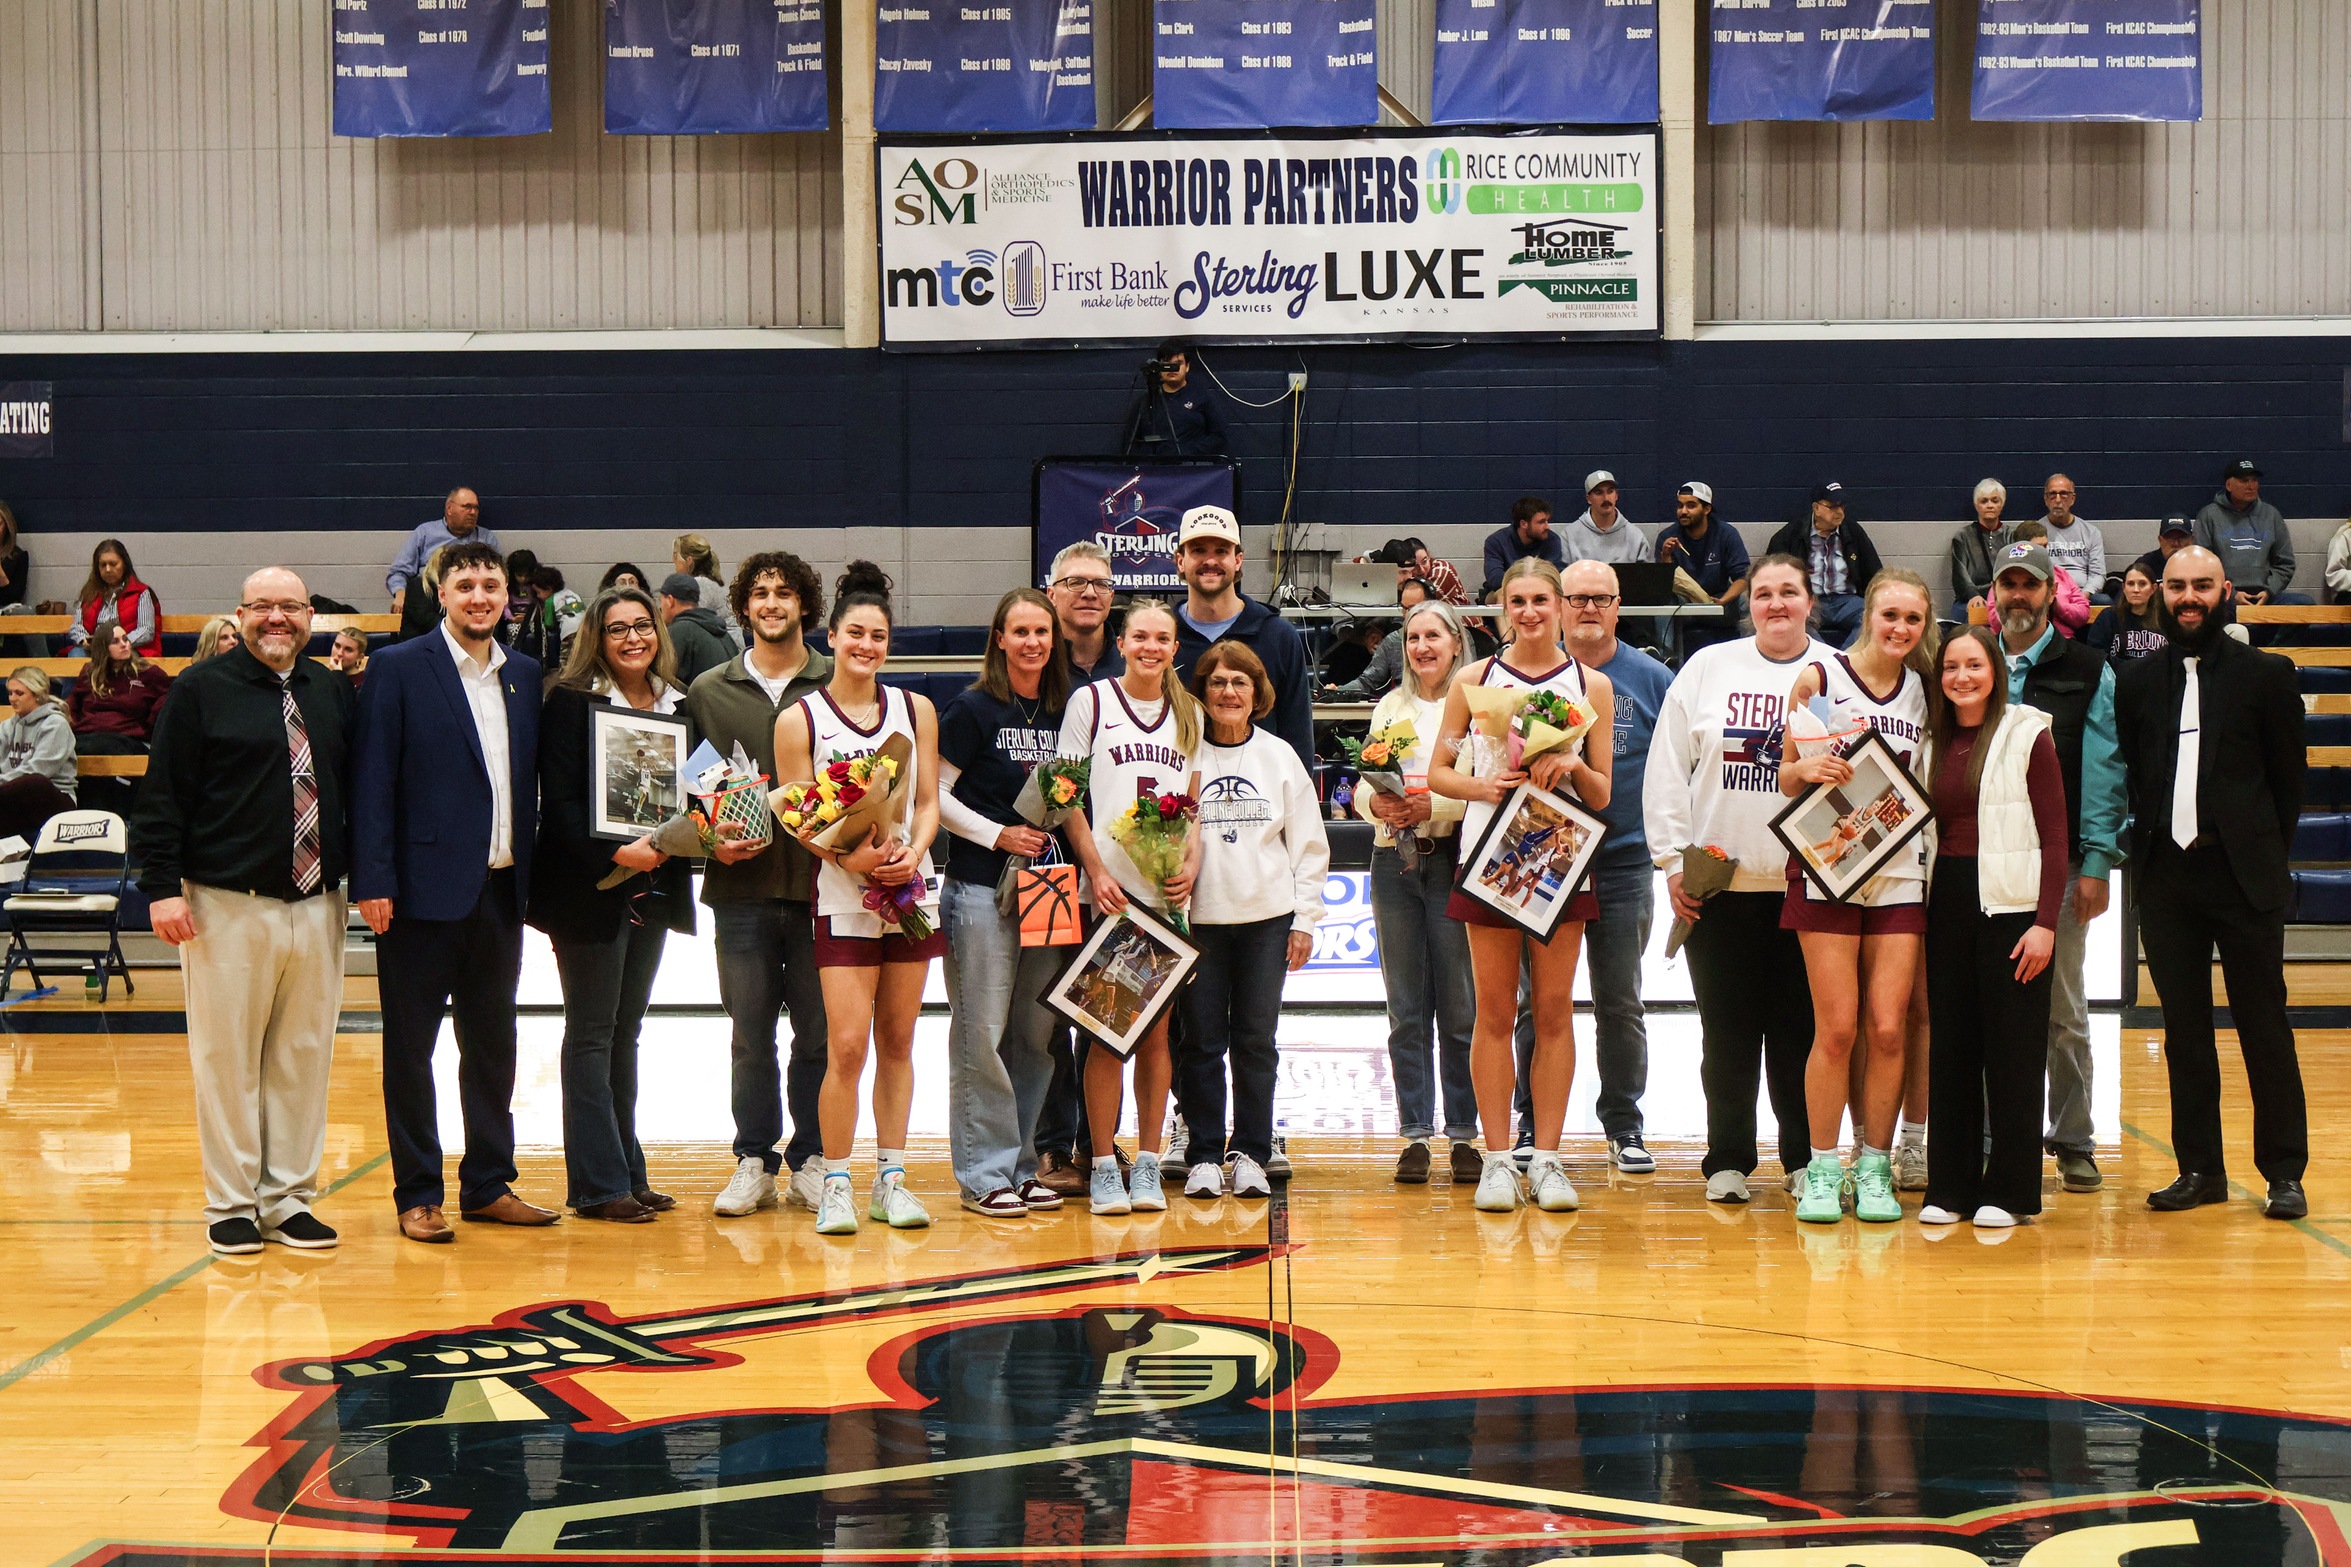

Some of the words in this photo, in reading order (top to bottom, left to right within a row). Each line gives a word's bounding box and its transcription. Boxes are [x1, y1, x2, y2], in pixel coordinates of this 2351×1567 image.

[961, 8, 980, 21] Class
[982, 8, 990, 20] of
[1158, 22, 1172, 35] Tom
[1174, 22, 1194, 35] Clark
[1241, 21, 1261, 34] Class
[1262, 22, 1270, 34] of
[1271, 22, 1291, 35] 1983
[1339, 18, 1373, 34] Basketball
[2010, 23, 2032, 35] Men's
[2033, 22, 2070, 35] Basketball
[2071, 22, 2089, 34] Team
[2106, 22, 2124, 34] First
[2125, 22, 2146, 35] KCAC
[2147, 21, 2195, 36] Championship
[418, 31, 438, 43] Class
[439, 31, 446, 42] of
[1437, 30, 1460, 42] Amber
[1461, 30, 1469, 42] J.
[1471, 29, 1489, 41] Lane
[1518, 28, 1538, 41] Class
[1539, 28, 1547, 41] of
[1626, 27, 1652, 40] Soccer
[1714, 30, 1732, 43] 1987
[1734, 30, 1757, 43] Men's
[1758, 30, 1784, 43] Soccer
[1785, 30, 1804, 42] Team
[1820, 28, 1839, 41] First
[1840, 28, 1860, 41] KCAC
[1911, 26, 1930, 39] Team
[691, 45, 710, 57] Class
[712, 45, 720, 57] of
[721, 45, 740, 57] 1971
[961, 58, 980, 71] Class
[982, 58, 990, 71] of
[1158, 56, 1186, 69] Wendell
[1187, 55, 1224, 69] Donaldson
[1241, 55, 1261, 68] Class
[1262, 55, 1270, 68] of
[1271, 55, 1291, 68] 1988
[1327, 54, 1349, 68] Track
[1349, 53, 1356, 67] &
[1356, 52, 1374, 66] Field
[2010, 56, 2043, 69] Women's
[2043, 56, 2080, 69] Basketball
[2080, 56, 2099, 69] Team
[2106, 56, 2124, 68] First
[2125, 56, 2146, 69] KCAC
[2147, 55, 2197, 69] Championship
[336, 64, 354, 77] Mrs.
[1056, 73, 1092, 87] Basketball
[1466, 153, 1508, 180] RICE
[1515, 152, 1641, 180] COMMUNITY
[991, 173, 1052, 182] ALLIANCE
[991, 179, 1075, 189] ORTHOPEDICS
[1002, 187, 1046, 196] SPORTS
[1078, 158, 1231, 227] WARRIOR
[1244, 155, 1419, 226] PARTNERS
[991, 194, 1052, 204] MEDICINE
[1494, 190, 1616, 211] HEALTH
[1525, 248, 1616, 260] LUMBER
[1051, 262, 1102, 291] First
[1109, 261, 1169, 290] Bank
[1325, 248, 1485, 302] LUXE
[887, 259, 995, 307] mtc
[1173, 249, 1319, 319] Sterling
[1550, 283, 1630, 295] PINNACLE
[1080, 294, 1112, 308] make
[1114, 291, 1134, 310] life
[1136, 293, 1170, 307] better
[1565, 303, 1628, 311] REHABILITATION
[1222, 304, 1272, 313] SERVICES
[1363, 306, 1450, 316] KANSAS
[1580, 310, 1638, 319] PERFORMANCE
[1095, 532, 1179, 553] STERLING
[1112, 551, 1172, 560] OLLEGE
[1726, 692, 1785, 728] STERL
[996, 727, 1038, 750] STERLING
[1108, 742, 1186, 773] WARRIORS
[1723, 763, 1780, 793] WARRI
[59, 820, 108, 838] WARRIORS
